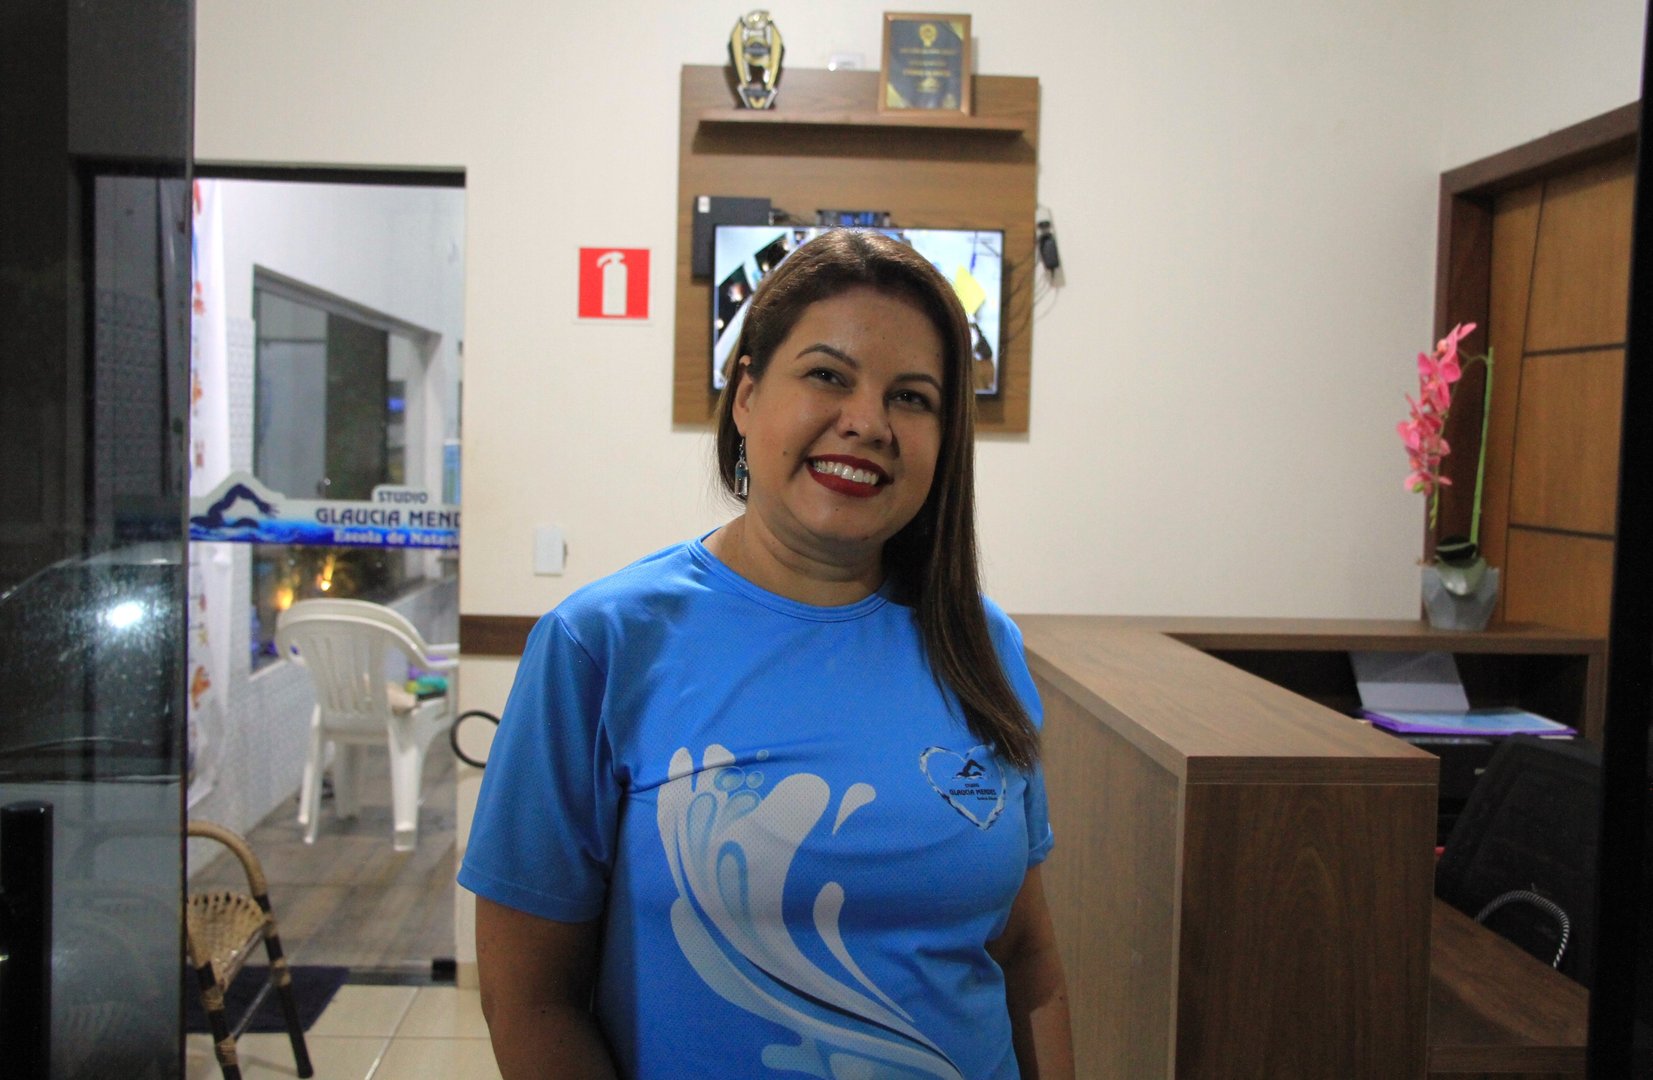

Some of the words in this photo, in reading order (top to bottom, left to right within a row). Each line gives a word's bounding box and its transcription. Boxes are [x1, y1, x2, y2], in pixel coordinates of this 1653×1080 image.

[378, 491, 428, 504] STUDIO
[316, 508, 400, 526] GLAUCIA
[386, 531, 406, 544] de
